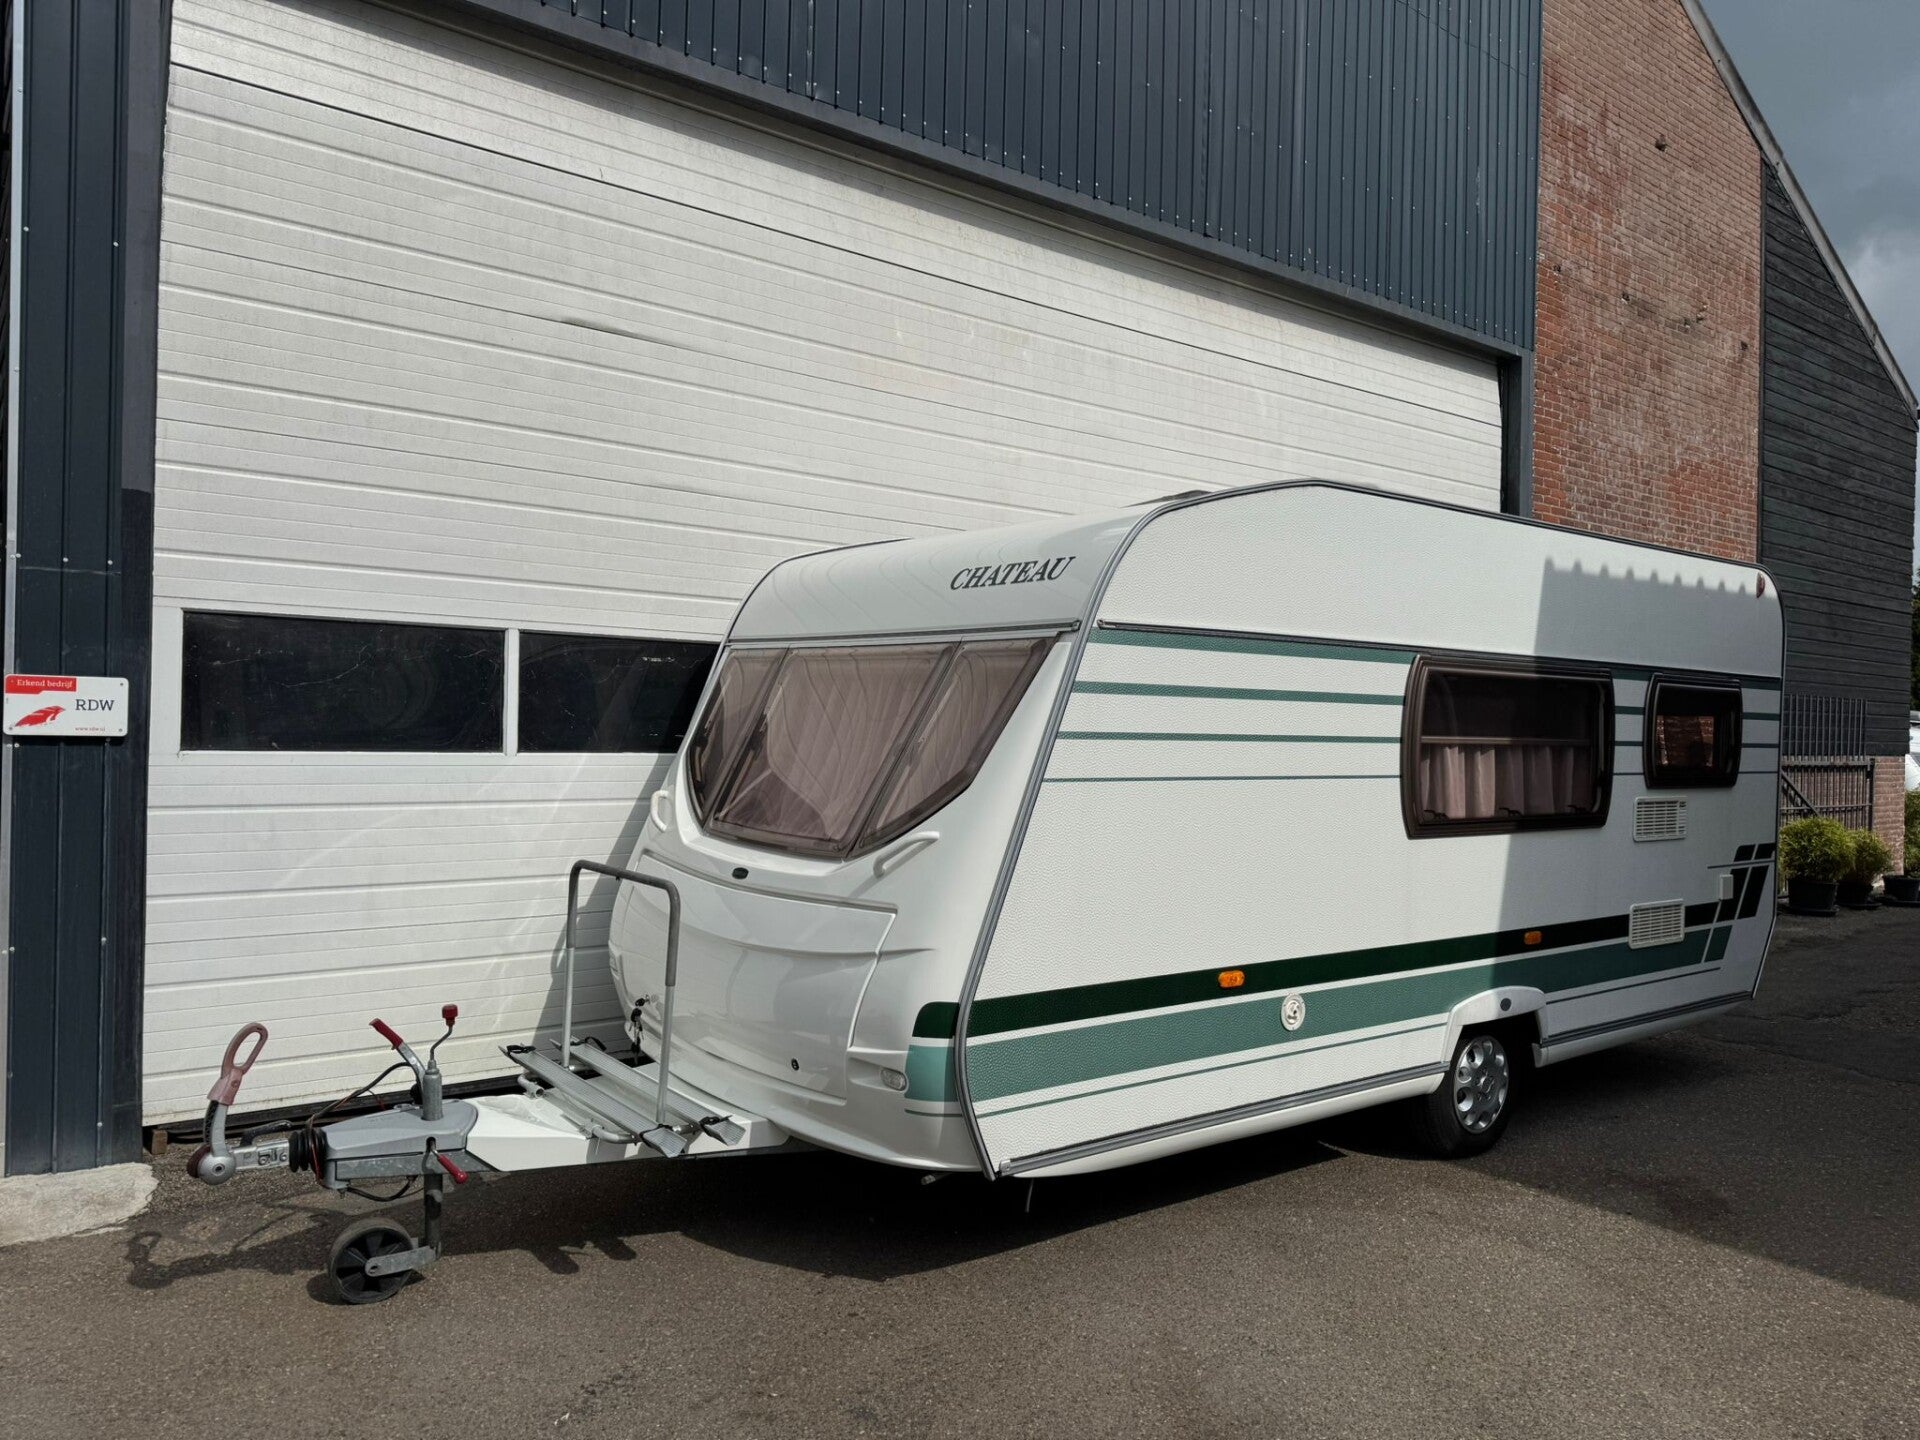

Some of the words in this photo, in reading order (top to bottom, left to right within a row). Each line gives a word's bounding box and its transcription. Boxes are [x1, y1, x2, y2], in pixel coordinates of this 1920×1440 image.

[950, 556, 1076, 590] CHATEAU
[17, 679, 46, 687] Erkend
[47, 680, 73, 689] bedrijf
[75, 699, 115, 711] RDW
